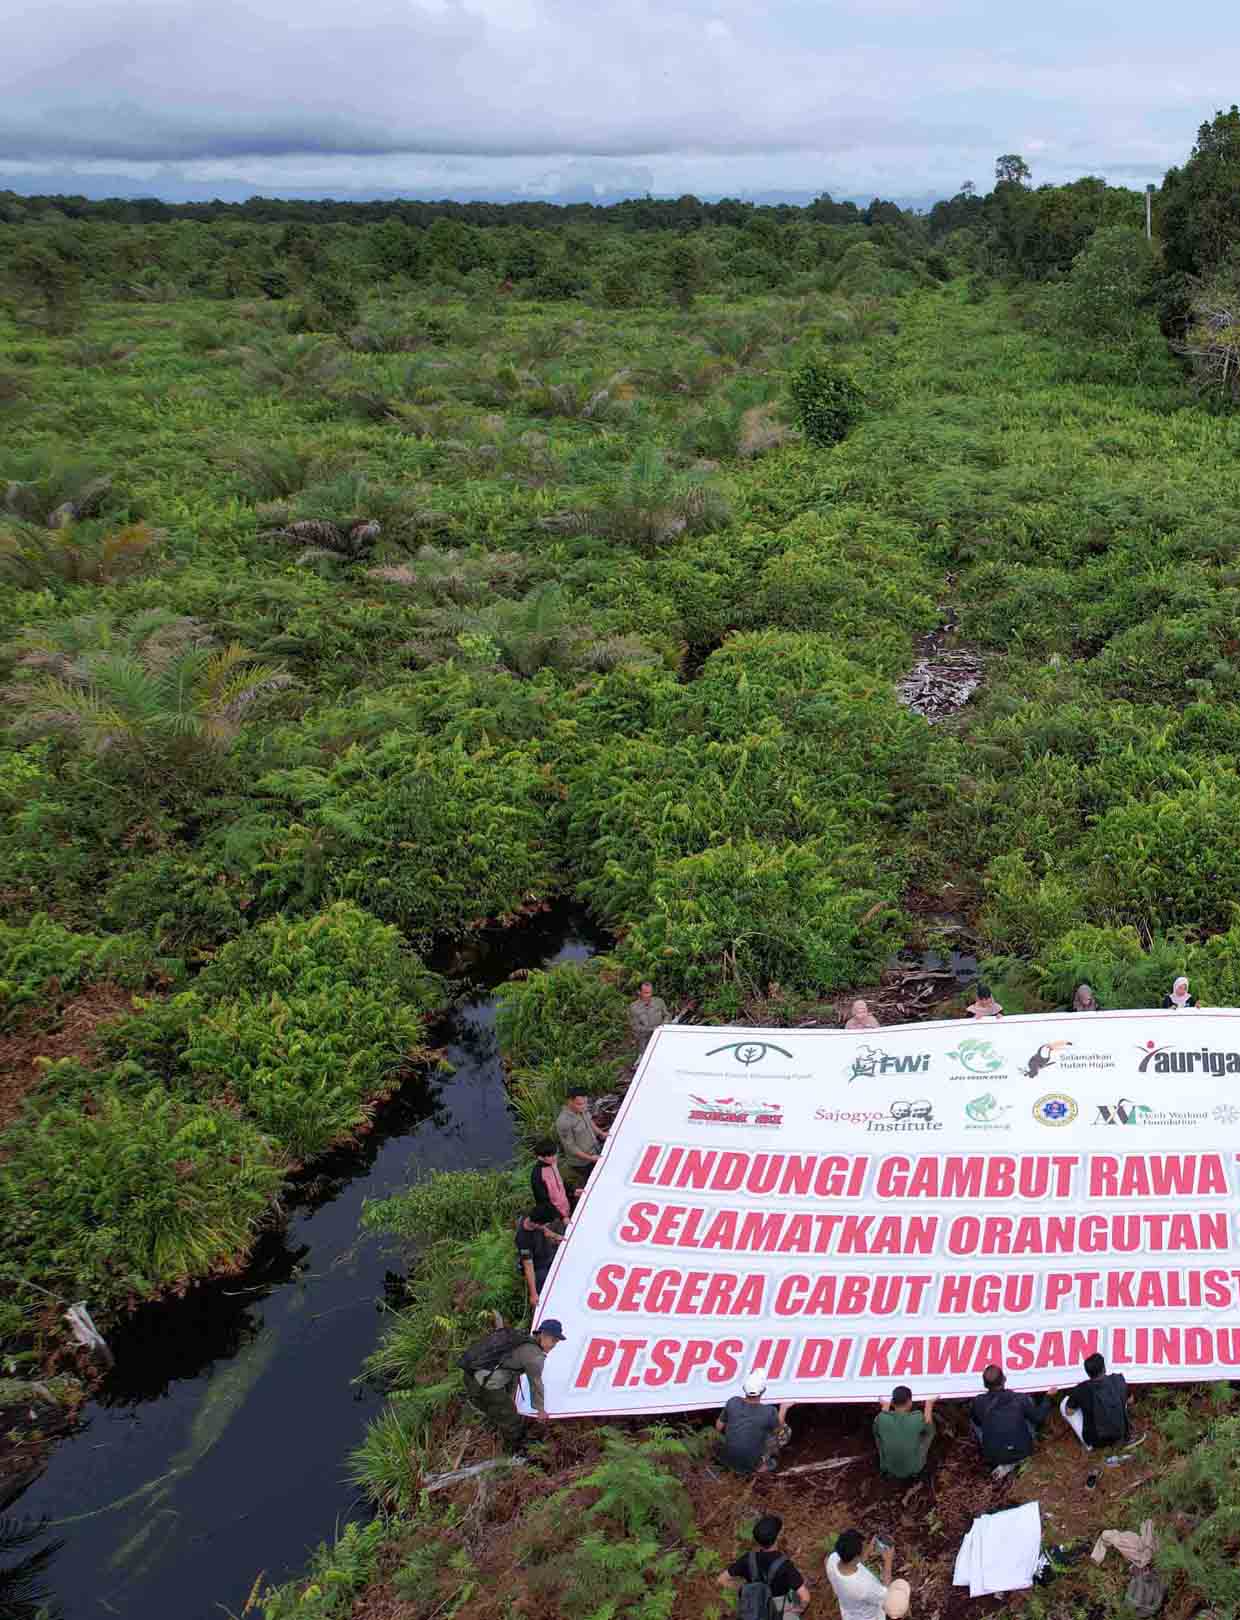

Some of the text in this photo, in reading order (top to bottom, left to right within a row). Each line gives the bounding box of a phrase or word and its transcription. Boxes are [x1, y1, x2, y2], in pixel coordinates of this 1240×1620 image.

[1060, 1053, 1112, 1061] Selamatkan
[1060, 1061, 1115, 1071] Hutan Hujan
[814, 1108, 884, 1124] Sajogyo
[1143, 1119, 1198, 1127] Foundation
[866, 1119, 943, 1133] Institute
[633, 1146, 867, 1197] LINDUNGI
[876, 1156, 1079, 1198] GAMBUT
[1090, 1154, 1227, 1197] RAWA
[619, 1202, 938, 1254] SELAMATKAN
[948, 1213, 1229, 1255] ORANGUTAN
[587, 1264, 765, 1315] SEGERA
[774, 1274, 932, 1315] CABUT
[938, 1273, 1035, 1313] HGU
[575, 1338, 744, 1388] PT.SPS
[751, 1338, 791, 1380] II
[795, 1338, 853, 1378] DI
[859, 1328, 1099, 1377] KAWASAN
